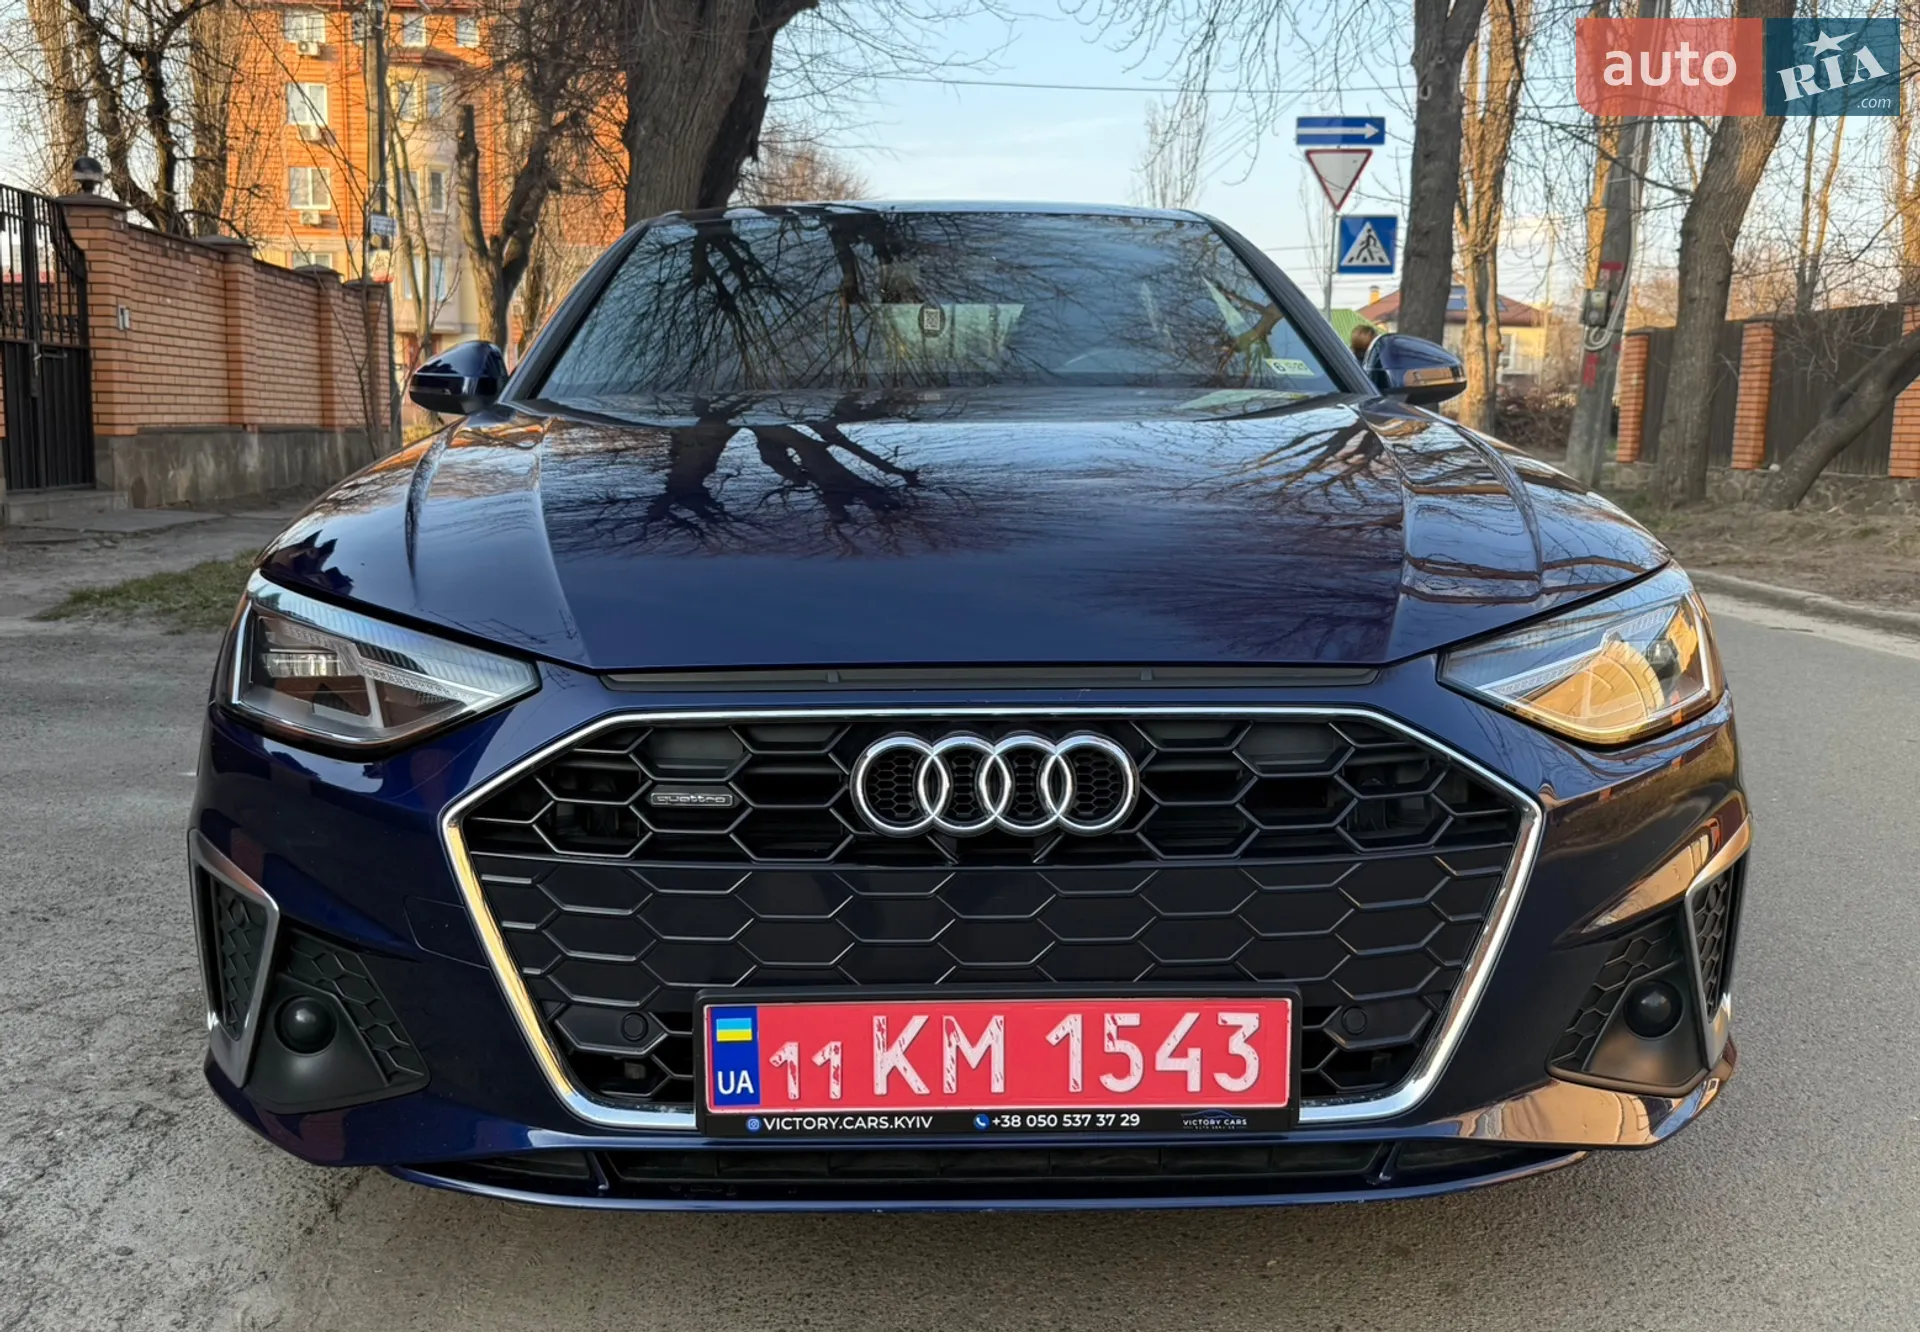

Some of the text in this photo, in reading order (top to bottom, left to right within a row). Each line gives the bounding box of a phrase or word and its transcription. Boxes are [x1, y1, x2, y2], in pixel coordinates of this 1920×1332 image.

[656, 795, 726, 803] quattro
[769, 1012, 1260, 1100] 11 KM 1543
[717, 1070, 754, 1095] UA
[763, 1116, 933, 1130] VICTORY.CARS.KYIV
[992, 1113, 1140, 1127] +38 050 537 37 29
